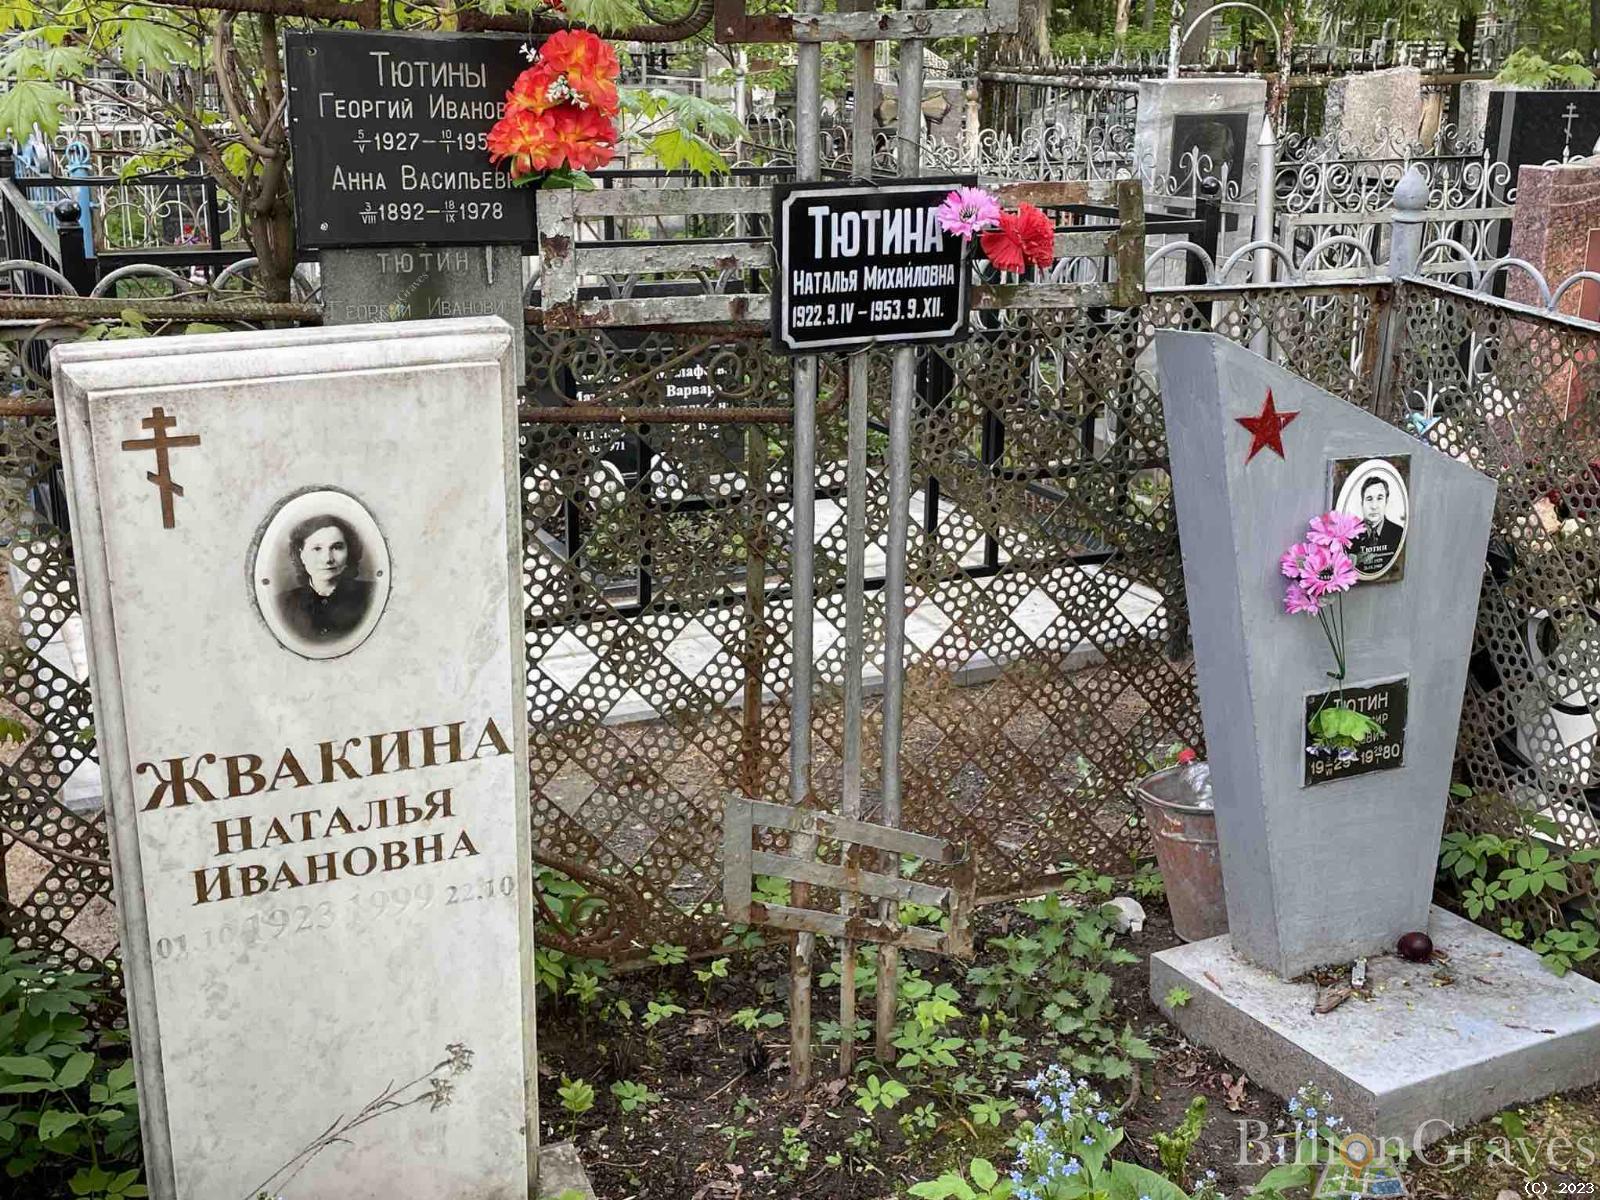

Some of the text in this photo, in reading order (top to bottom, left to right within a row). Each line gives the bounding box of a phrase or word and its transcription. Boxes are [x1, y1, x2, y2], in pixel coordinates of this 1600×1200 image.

[369, 51, 486, 88] ТЮТИНЫ
[318, 92, 506, 120] ГЕОРГИЙ ИВАНОВ
[457, 132, 488, 151] 195
[331, 164, 387, 191] АННА
[808, 205, 944, 260] ТЮТИНА
[377, 252, 469, 273] ТЮТИН
[793, 261, 955, 296] НАТАЛЬЯ МИХАЙЛОВНА
[427, 296, 505, 316] ИВАНОВИ
[136, 717, 513, 812] ЖВАКИНА
[212, 787, 457, 857] НАТАЛЬЯ
[192, 829, 480, 906] ИВАНОВНА
[240, 901, 335, 945] 1923
[446, 875, 514, 906] 22.10
